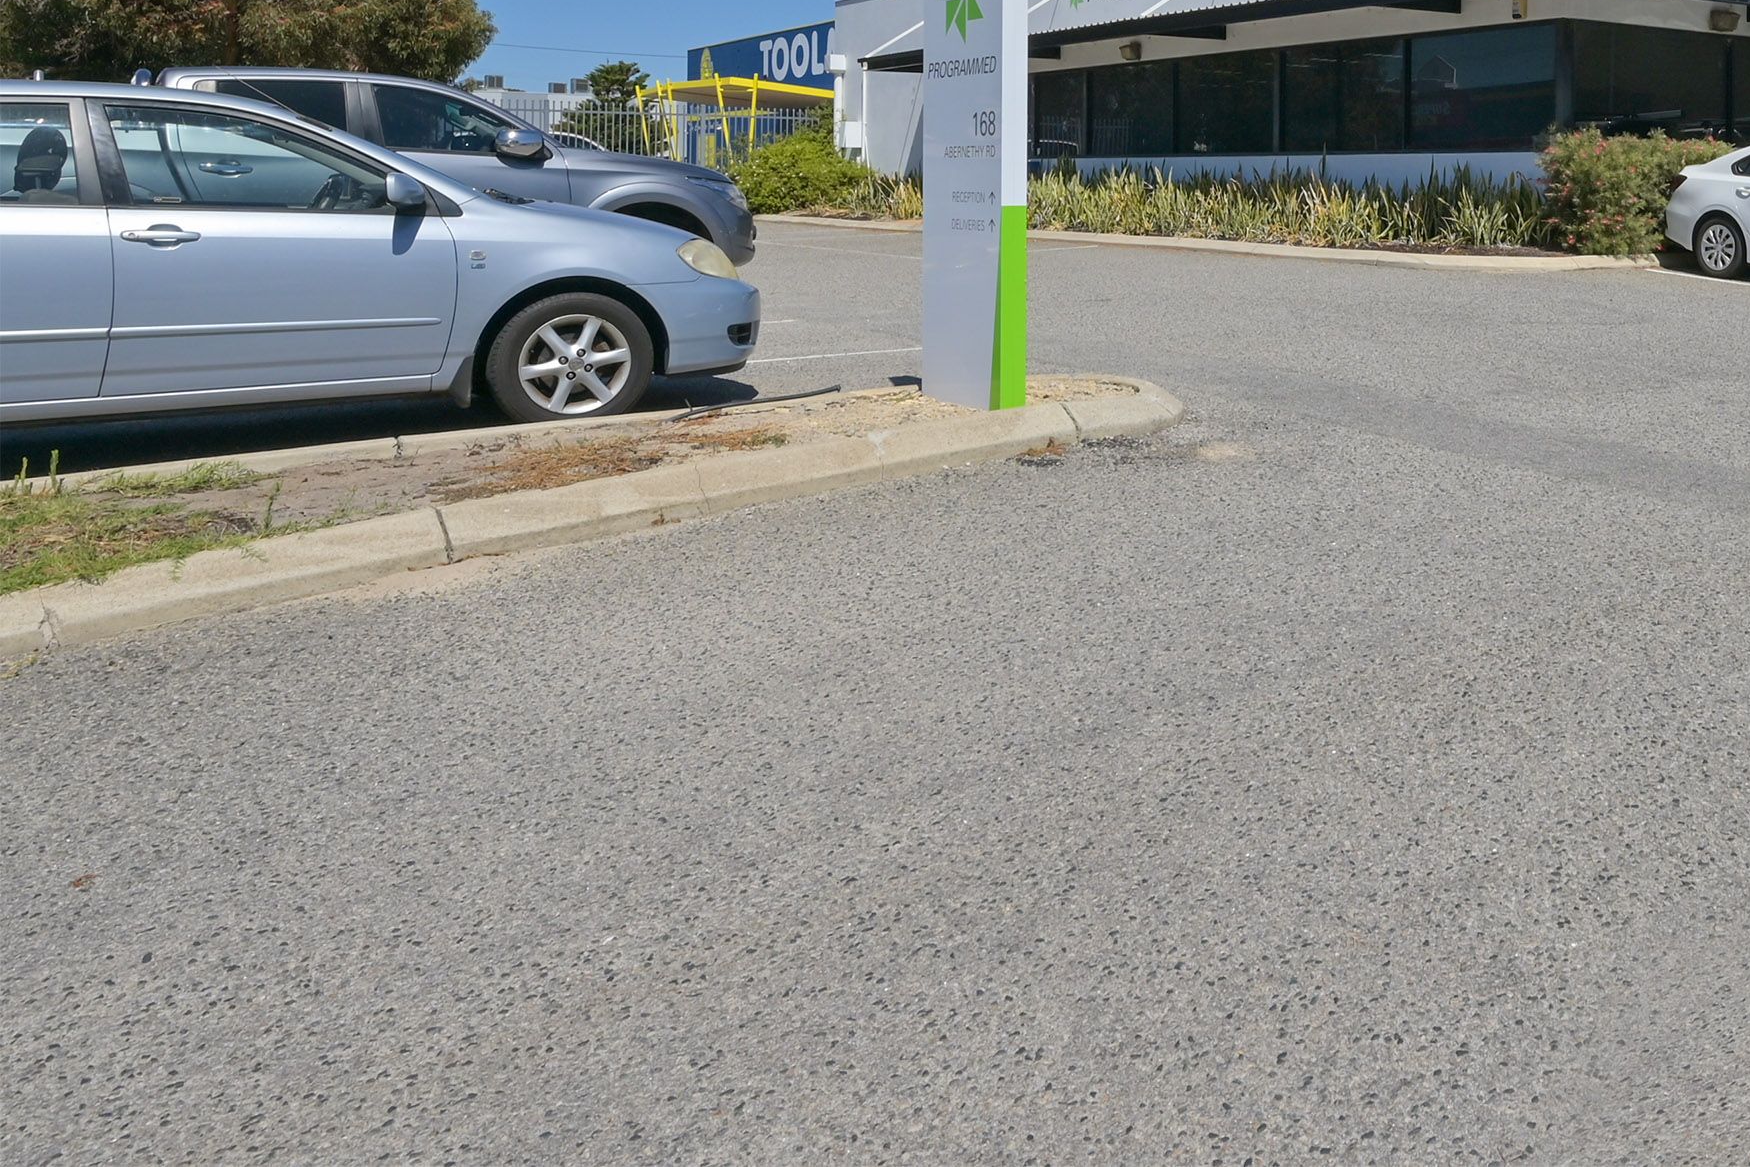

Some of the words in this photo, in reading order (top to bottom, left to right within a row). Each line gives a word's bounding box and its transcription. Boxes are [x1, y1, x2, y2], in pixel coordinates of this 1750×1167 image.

[927, 55, 997, 80] PROGRAMMED
[972, 110, 996, 137] 168
[943, 145, 984, 159] ABERNETHY
[985, 144, 996, 158] RD
[951, 190, 986, 204] RECEPTION
[951, 218, 985, 232] DELIVERIES
